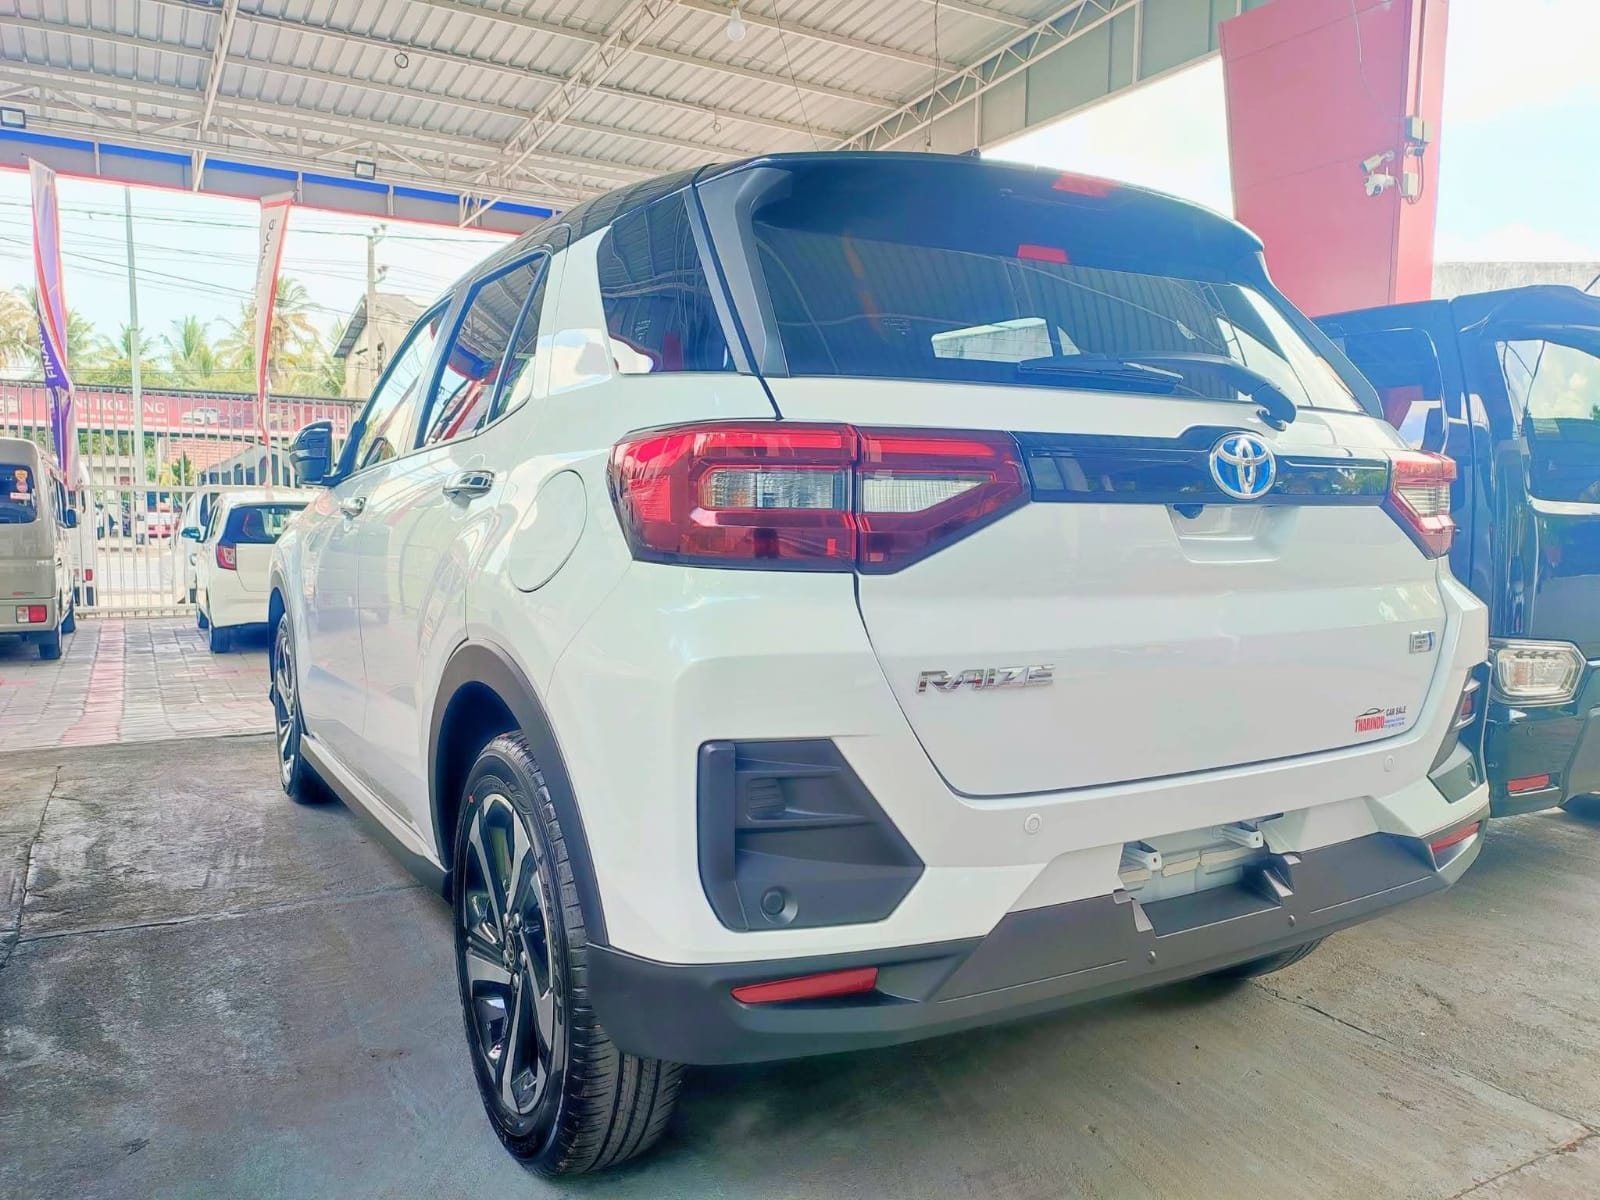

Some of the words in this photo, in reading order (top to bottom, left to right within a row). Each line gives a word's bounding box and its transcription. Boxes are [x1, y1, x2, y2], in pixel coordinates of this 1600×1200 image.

[95, 398, 166, 414] HOLDNG
[915, 664, 1056, 694] RAIZE
[1386, 707, 1395, 717] CAR
[1396, 705, 1407, 715] SALE
[1355, 715, 1385, 733] THARINDU
